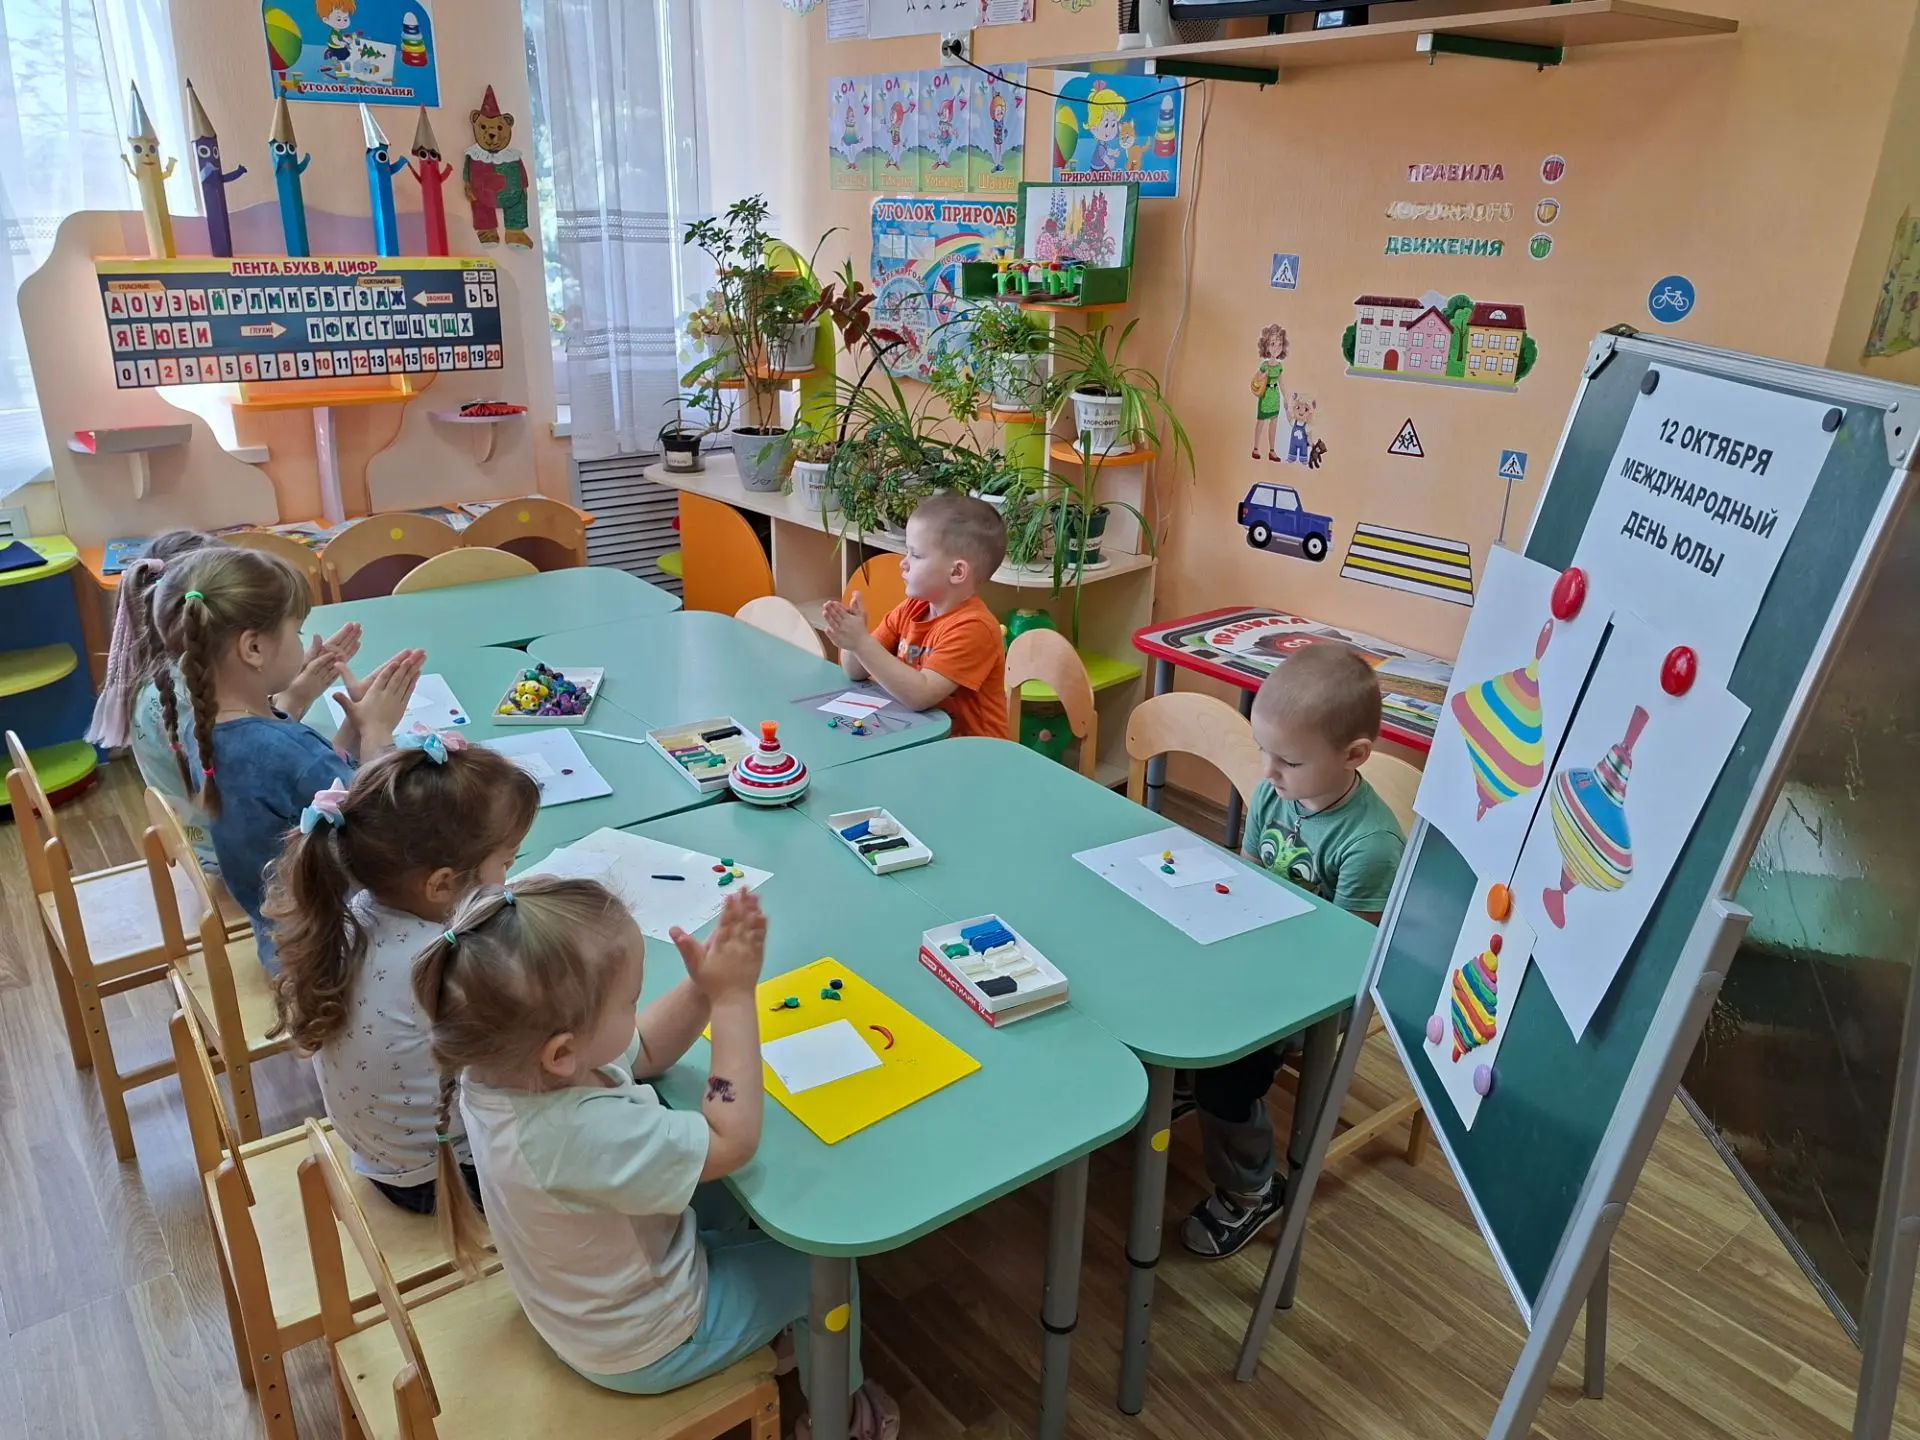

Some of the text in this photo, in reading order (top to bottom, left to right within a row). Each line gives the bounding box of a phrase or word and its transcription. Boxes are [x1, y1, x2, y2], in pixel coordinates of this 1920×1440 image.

[301, 83, 414, 97] УГОЛОК РИСОВАНИЯ
[1060, 170, 1169, 182] ПРИРОДНЫЙ УГОЛОК
[1408, 164, 1504, 183] ПРАВИЛА
[877, 203, 934, 221] УГОЛОК
[1384, 236, 1504, 257] ДВИЖЕНИЯ
[231, 261, 378, 275] ЛЕНТА БУКВ И ЦИФР
[122, 350, 500, 381] 0 1 2 3 4 5 6 7 8 9 10 11 12 13 14 15 16 17 18 19 20
[1659, 418, 1774, 476] 12 ОКТЯБРЯ
[1620, 457, 1778, 539] МЕЖДУНАРОДНЫЙ
[1620, 510, 1725, 577] ДЕНЬ ЮЛЫ
[1212, 618, 1311, 645] ПРАВИЛА
